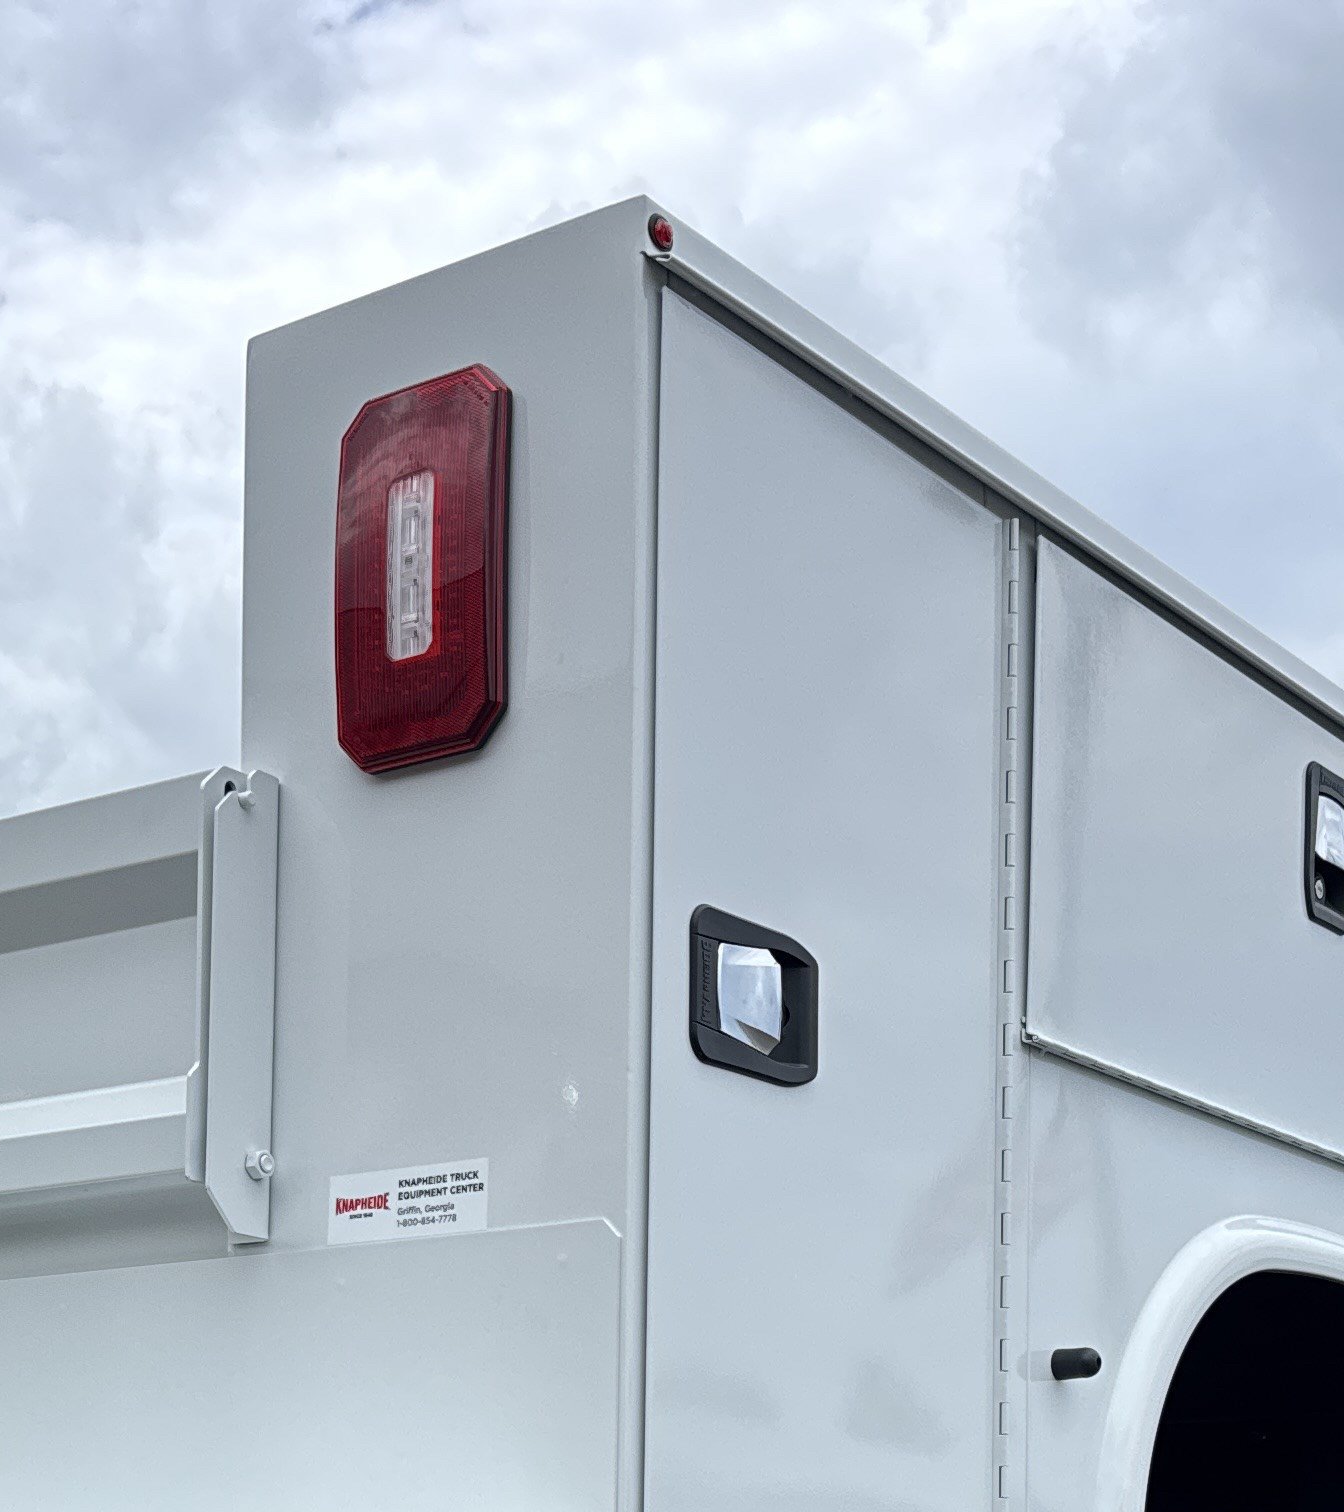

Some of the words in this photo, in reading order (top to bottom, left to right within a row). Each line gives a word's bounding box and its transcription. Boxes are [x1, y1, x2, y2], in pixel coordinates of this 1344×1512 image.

[398, 1173, 448, 1188] KNAPHEIDE
[450, 1170, 480, 1182] TRUCK
[397, 1186, 448, 1201] EQUIPMENT
[450, 1182, 485, 1194] CENTER
[335, 1192, 391, 1215] KNAPHEIDE
[397, 1204, 422, 1216] Griffin,
[425, 1202, 455, 1213] Georgia
[397, 1213, 457, 1228] 1-800-854-7778
